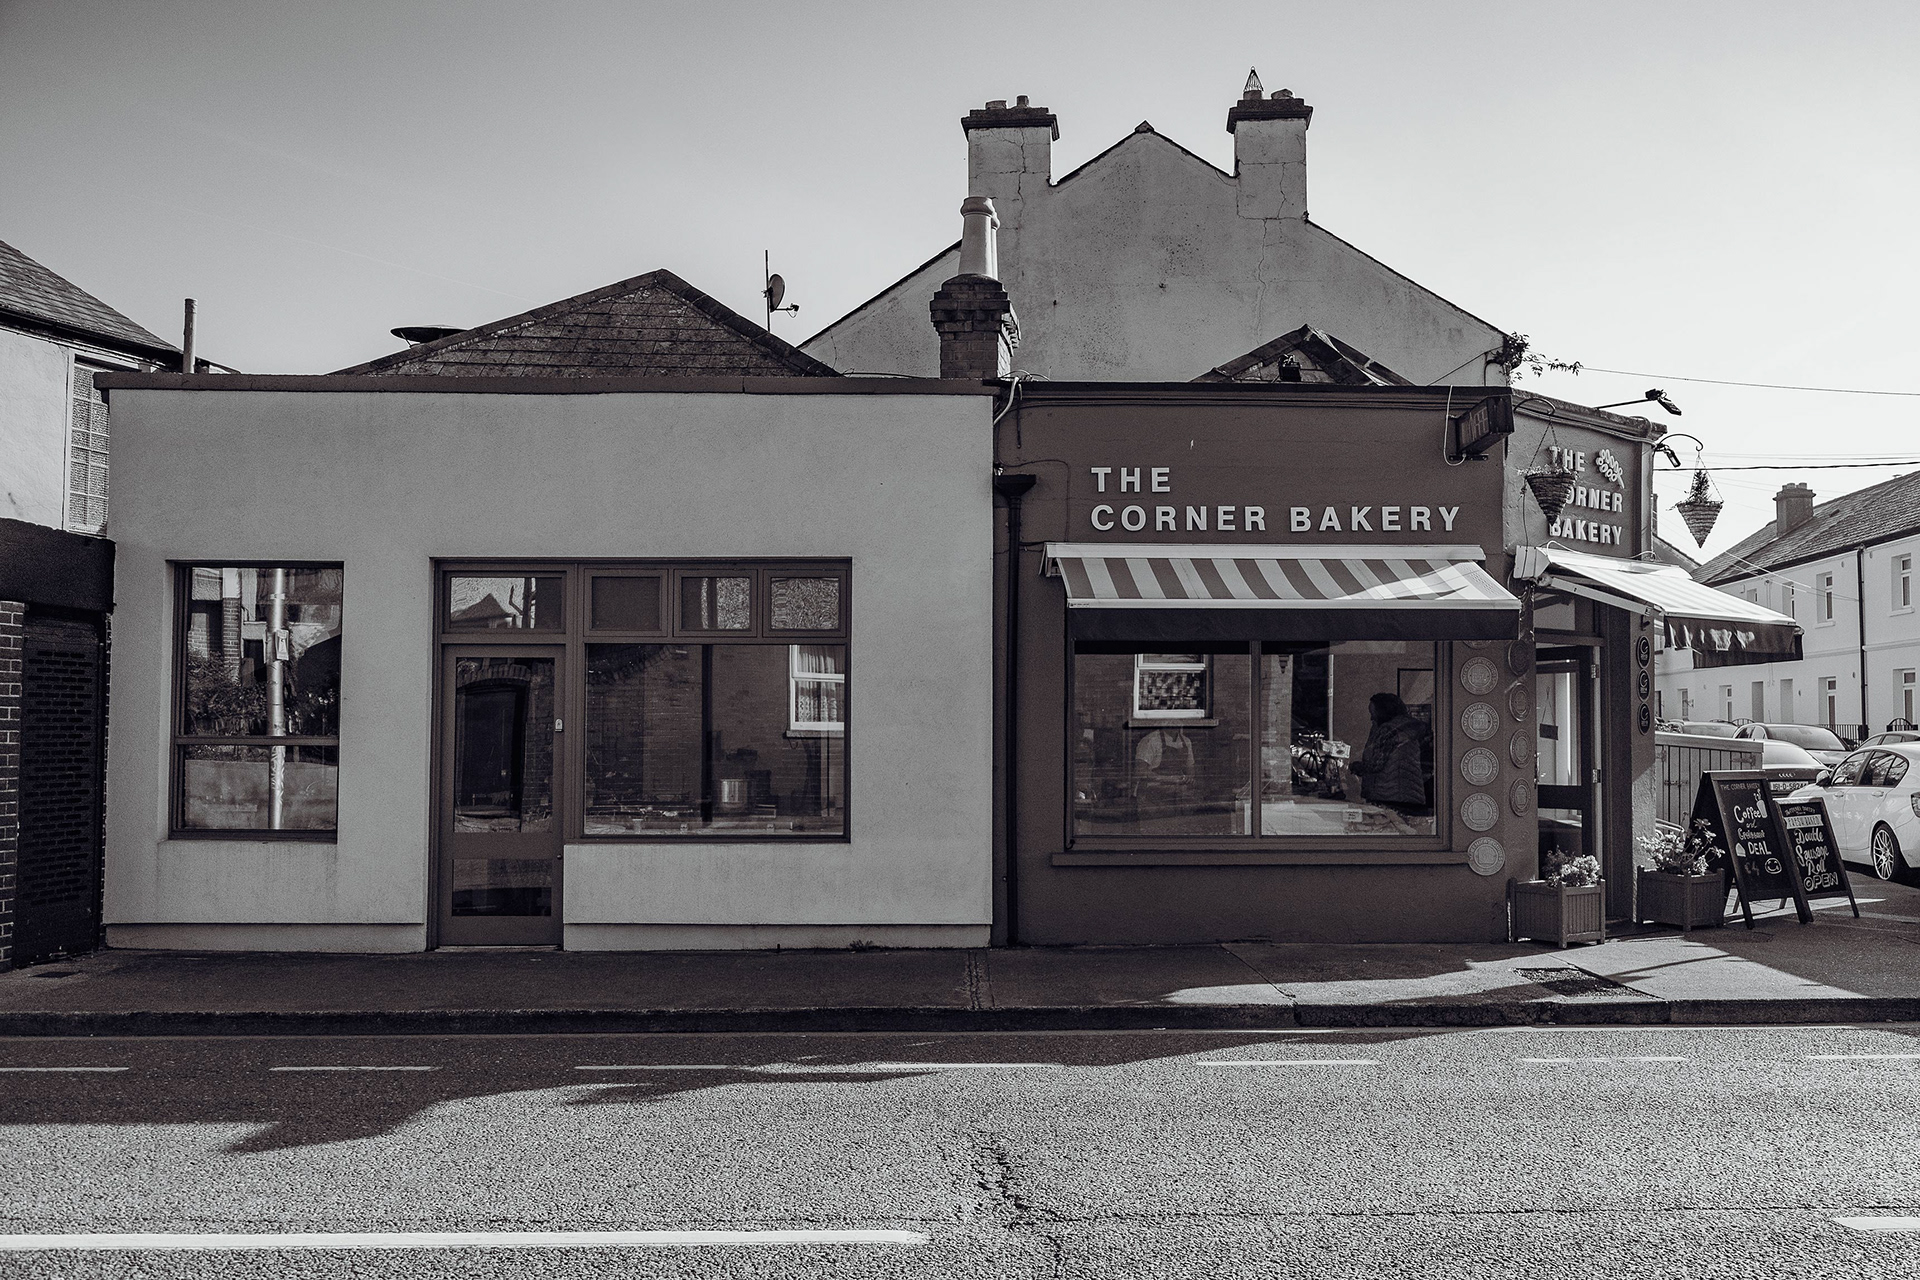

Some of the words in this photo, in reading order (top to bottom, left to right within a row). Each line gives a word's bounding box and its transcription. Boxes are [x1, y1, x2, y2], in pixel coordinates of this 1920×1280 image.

[1549, 446, 1586, 472] THE
[1091, 467, 1171, 493] THE
[1566, 486, 1623, 513] ORNER
[1091, 504, 1267, 532] CORNER
[1289, 506, 1460, 533] BAKERY
[1549, 518, 1623, 546] BAKERY
[1733, 805, 1762, 824] Coffee
[1794, 827, 1824, 845] Double
[1747, 840, 1772, 856] DEAL
[1795, 844, 1829, 867] Sausage
[1805, 857, 1827, 876] Roll
[1803, 872, 1839, 892] OPEN
